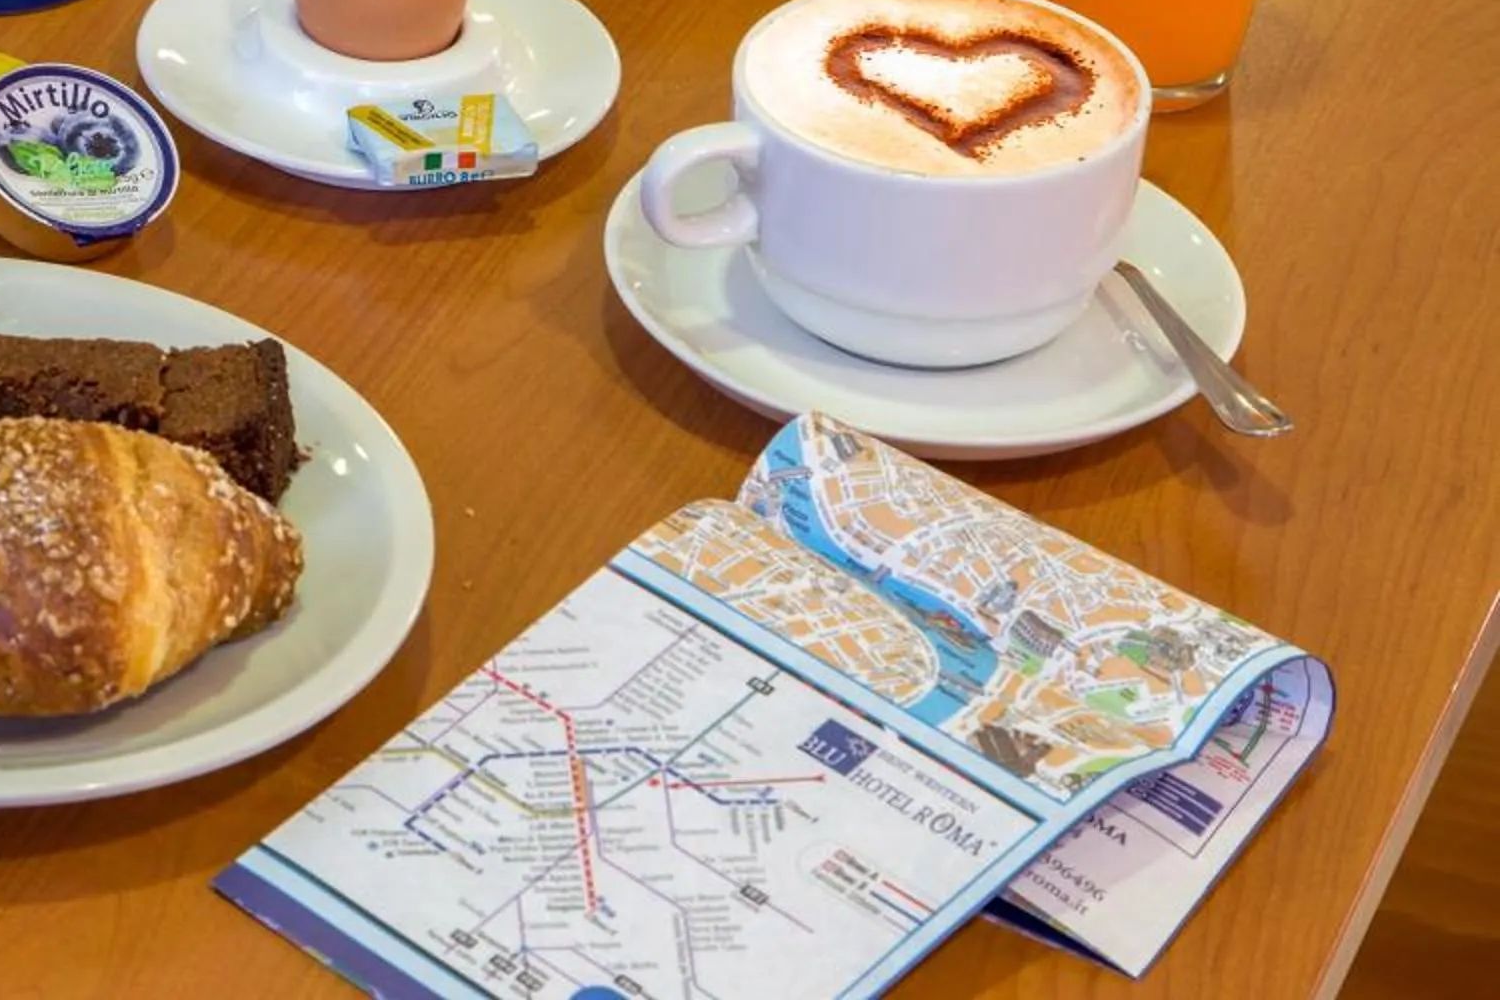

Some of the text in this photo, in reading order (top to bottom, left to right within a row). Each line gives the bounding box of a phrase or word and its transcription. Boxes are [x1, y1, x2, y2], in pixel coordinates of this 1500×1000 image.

[409, 171, 457, 186] BURRO
[802, 735, 846, 767] BLU
[877, 748, 980, 815] BEST WESTERN
[849, 767, 913, 816] HOTEL
[912, 806, 984, 857] ROMA
